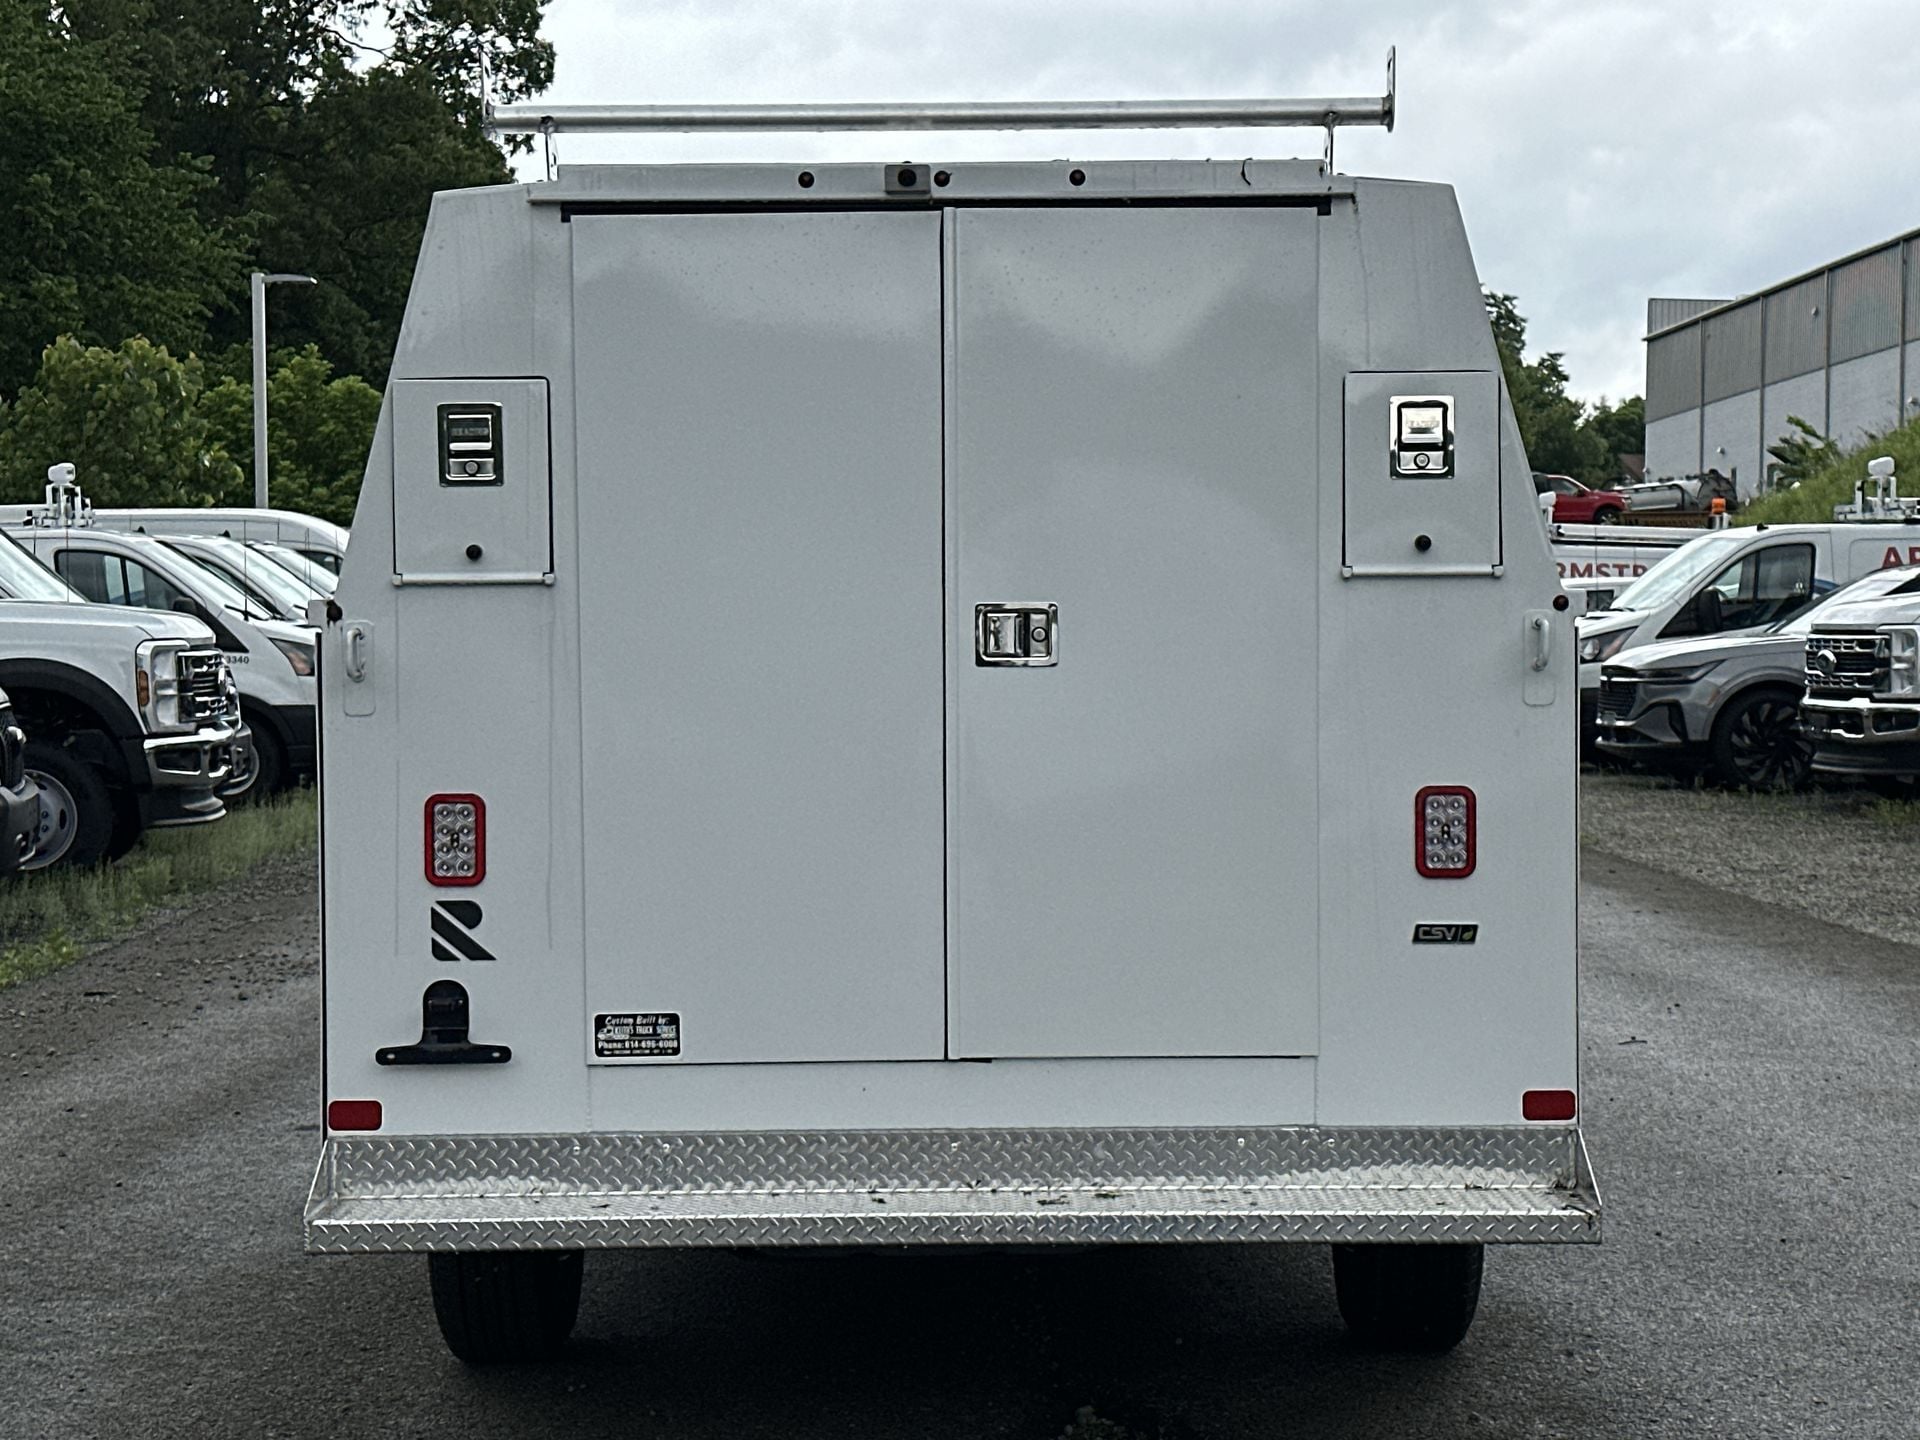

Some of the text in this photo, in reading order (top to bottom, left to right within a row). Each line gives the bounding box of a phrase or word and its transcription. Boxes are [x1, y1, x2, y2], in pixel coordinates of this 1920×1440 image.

[1418, 926, 1456, 941] CSV
[605, 1015, 634, 1026] Custom
[636, 1015, 656, 1025] Built
[636, 1025, 653, 1035] TRUCK
[598, 1040, 624, 1049] Phone:
